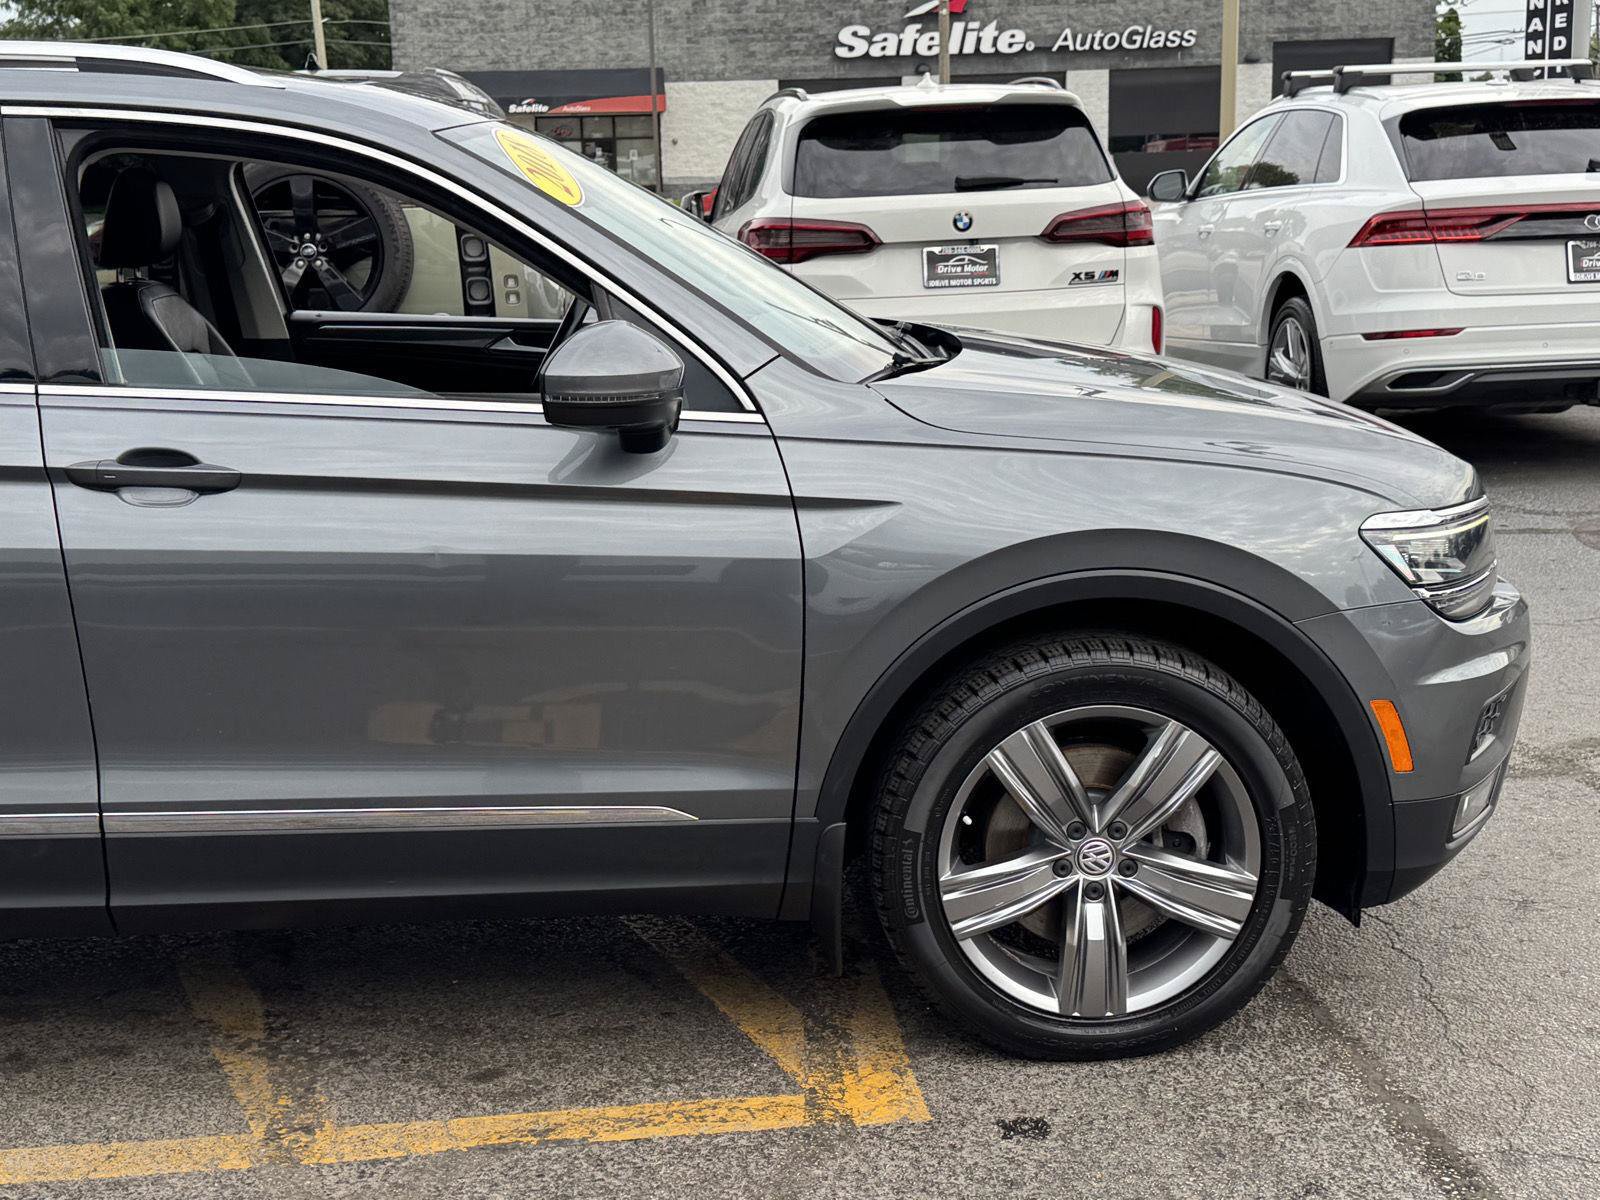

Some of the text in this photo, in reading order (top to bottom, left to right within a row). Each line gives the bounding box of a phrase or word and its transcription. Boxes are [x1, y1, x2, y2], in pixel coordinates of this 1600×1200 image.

[1051, 26, 1197, 52] AutoGlass
[1527, 0, 1544, 76] NAN
[508, 103, 549, 114] Safelite
[964, 264, 988, 272] Motor
[1072, 271, 1095, 281] X5
[902, 849, 919, 920] Continental
